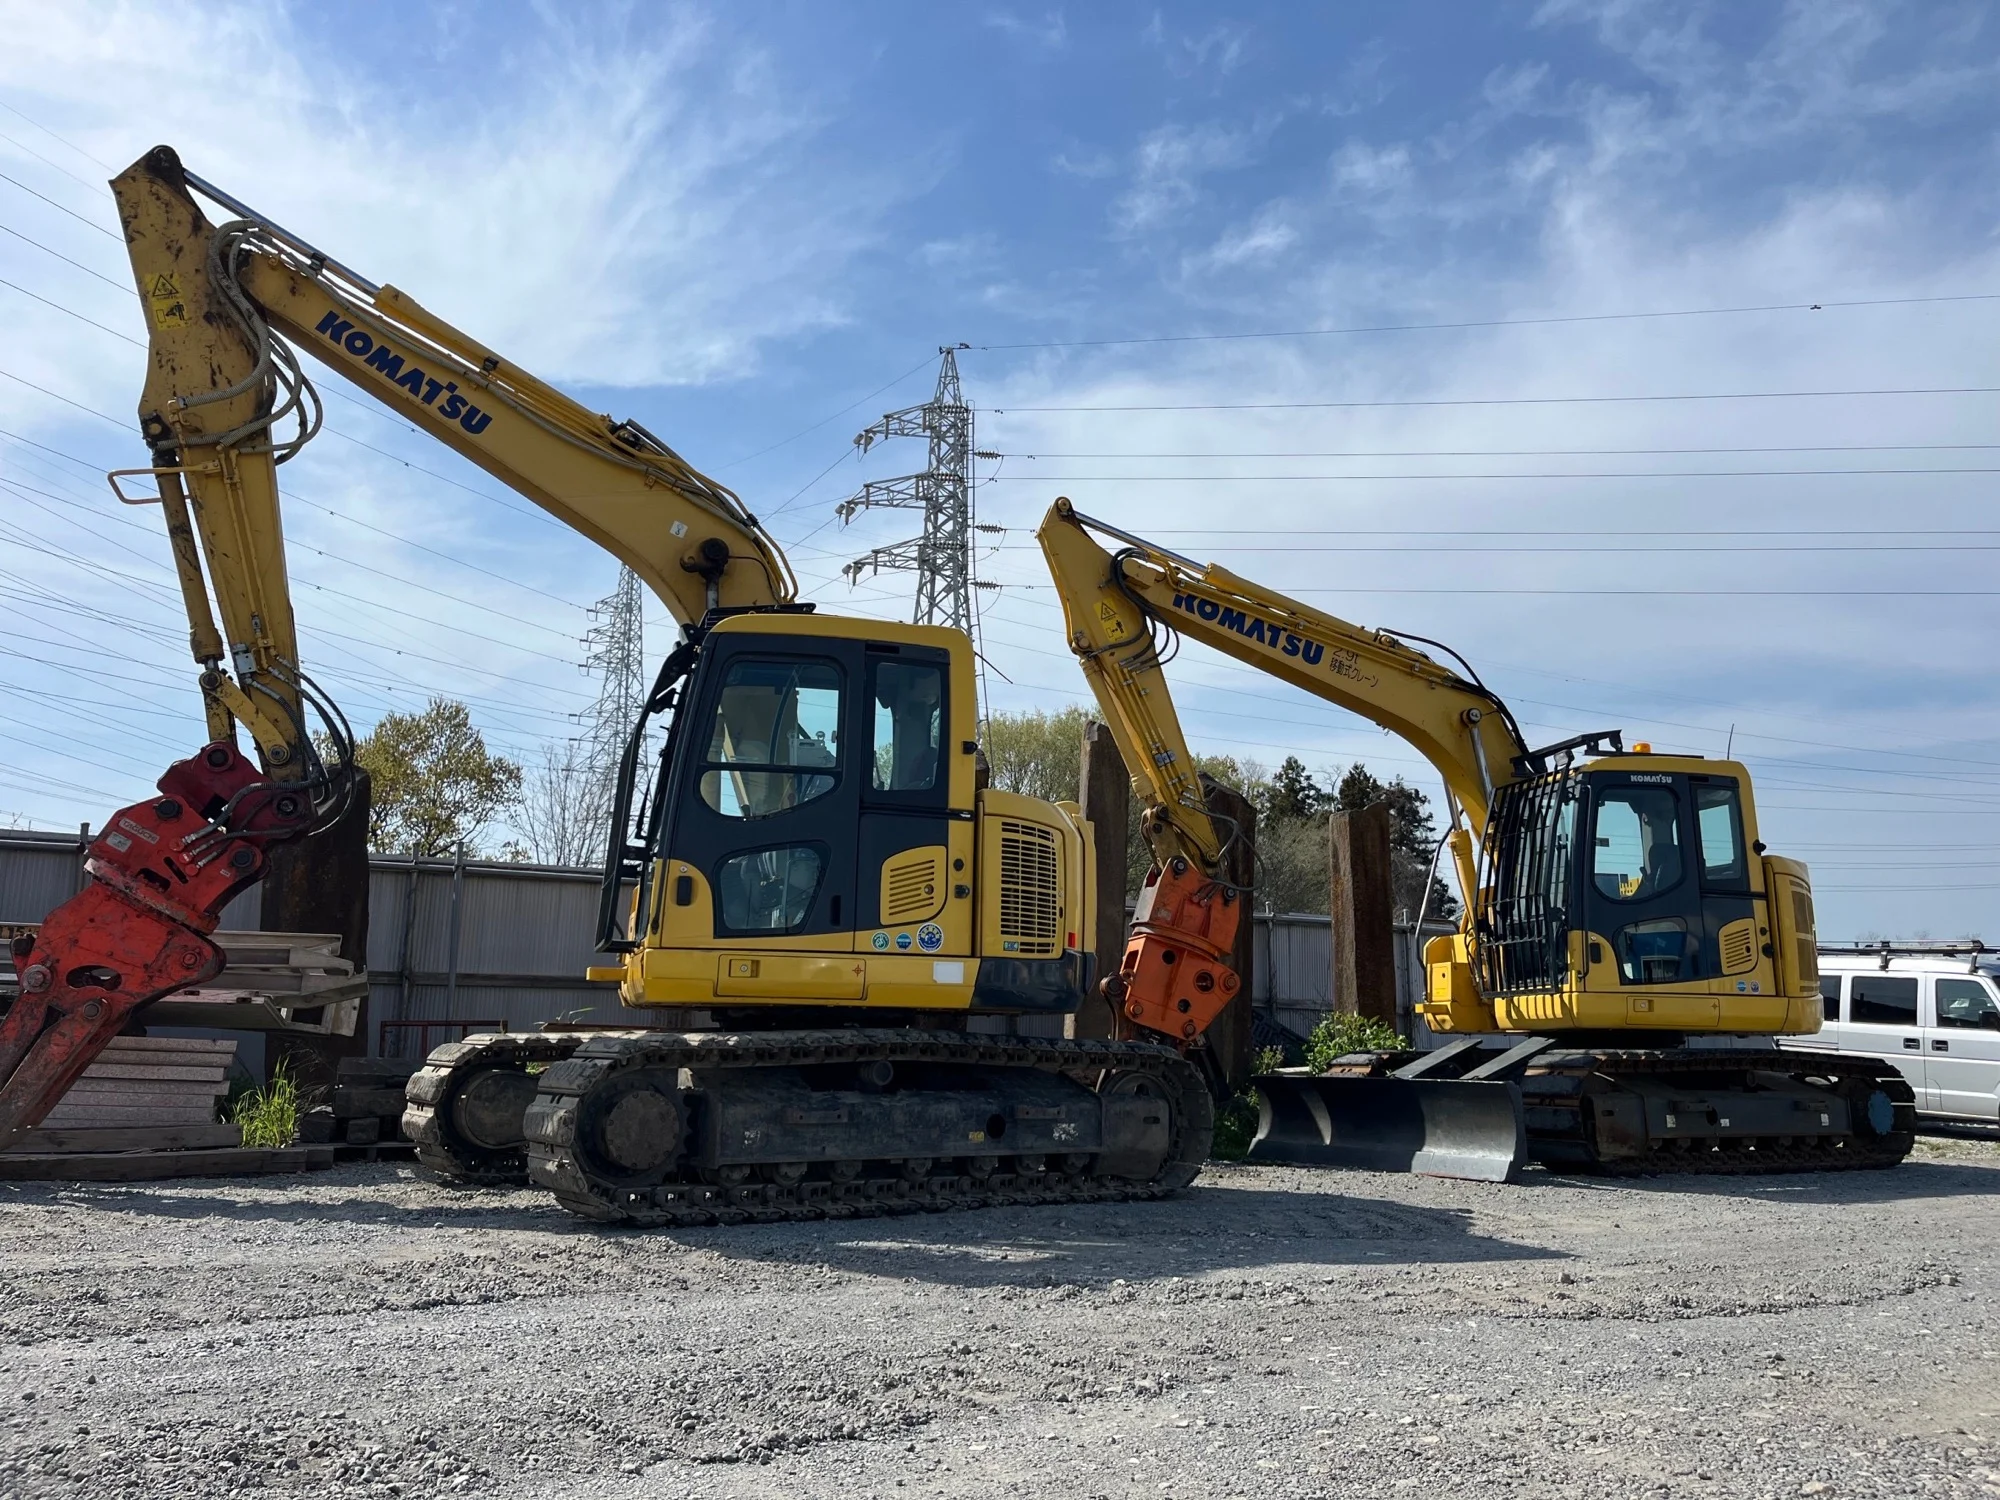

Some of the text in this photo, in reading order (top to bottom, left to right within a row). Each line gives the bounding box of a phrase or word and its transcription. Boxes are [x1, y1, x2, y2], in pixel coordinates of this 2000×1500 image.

[315, 310, 492, 435] KOMATSU
[1172, 594, 1324, 665] KOMATSU
[1329, 657, 1379, 688] 移動式クレーン
[1630, 774, 1672, 783] KOMATSU
